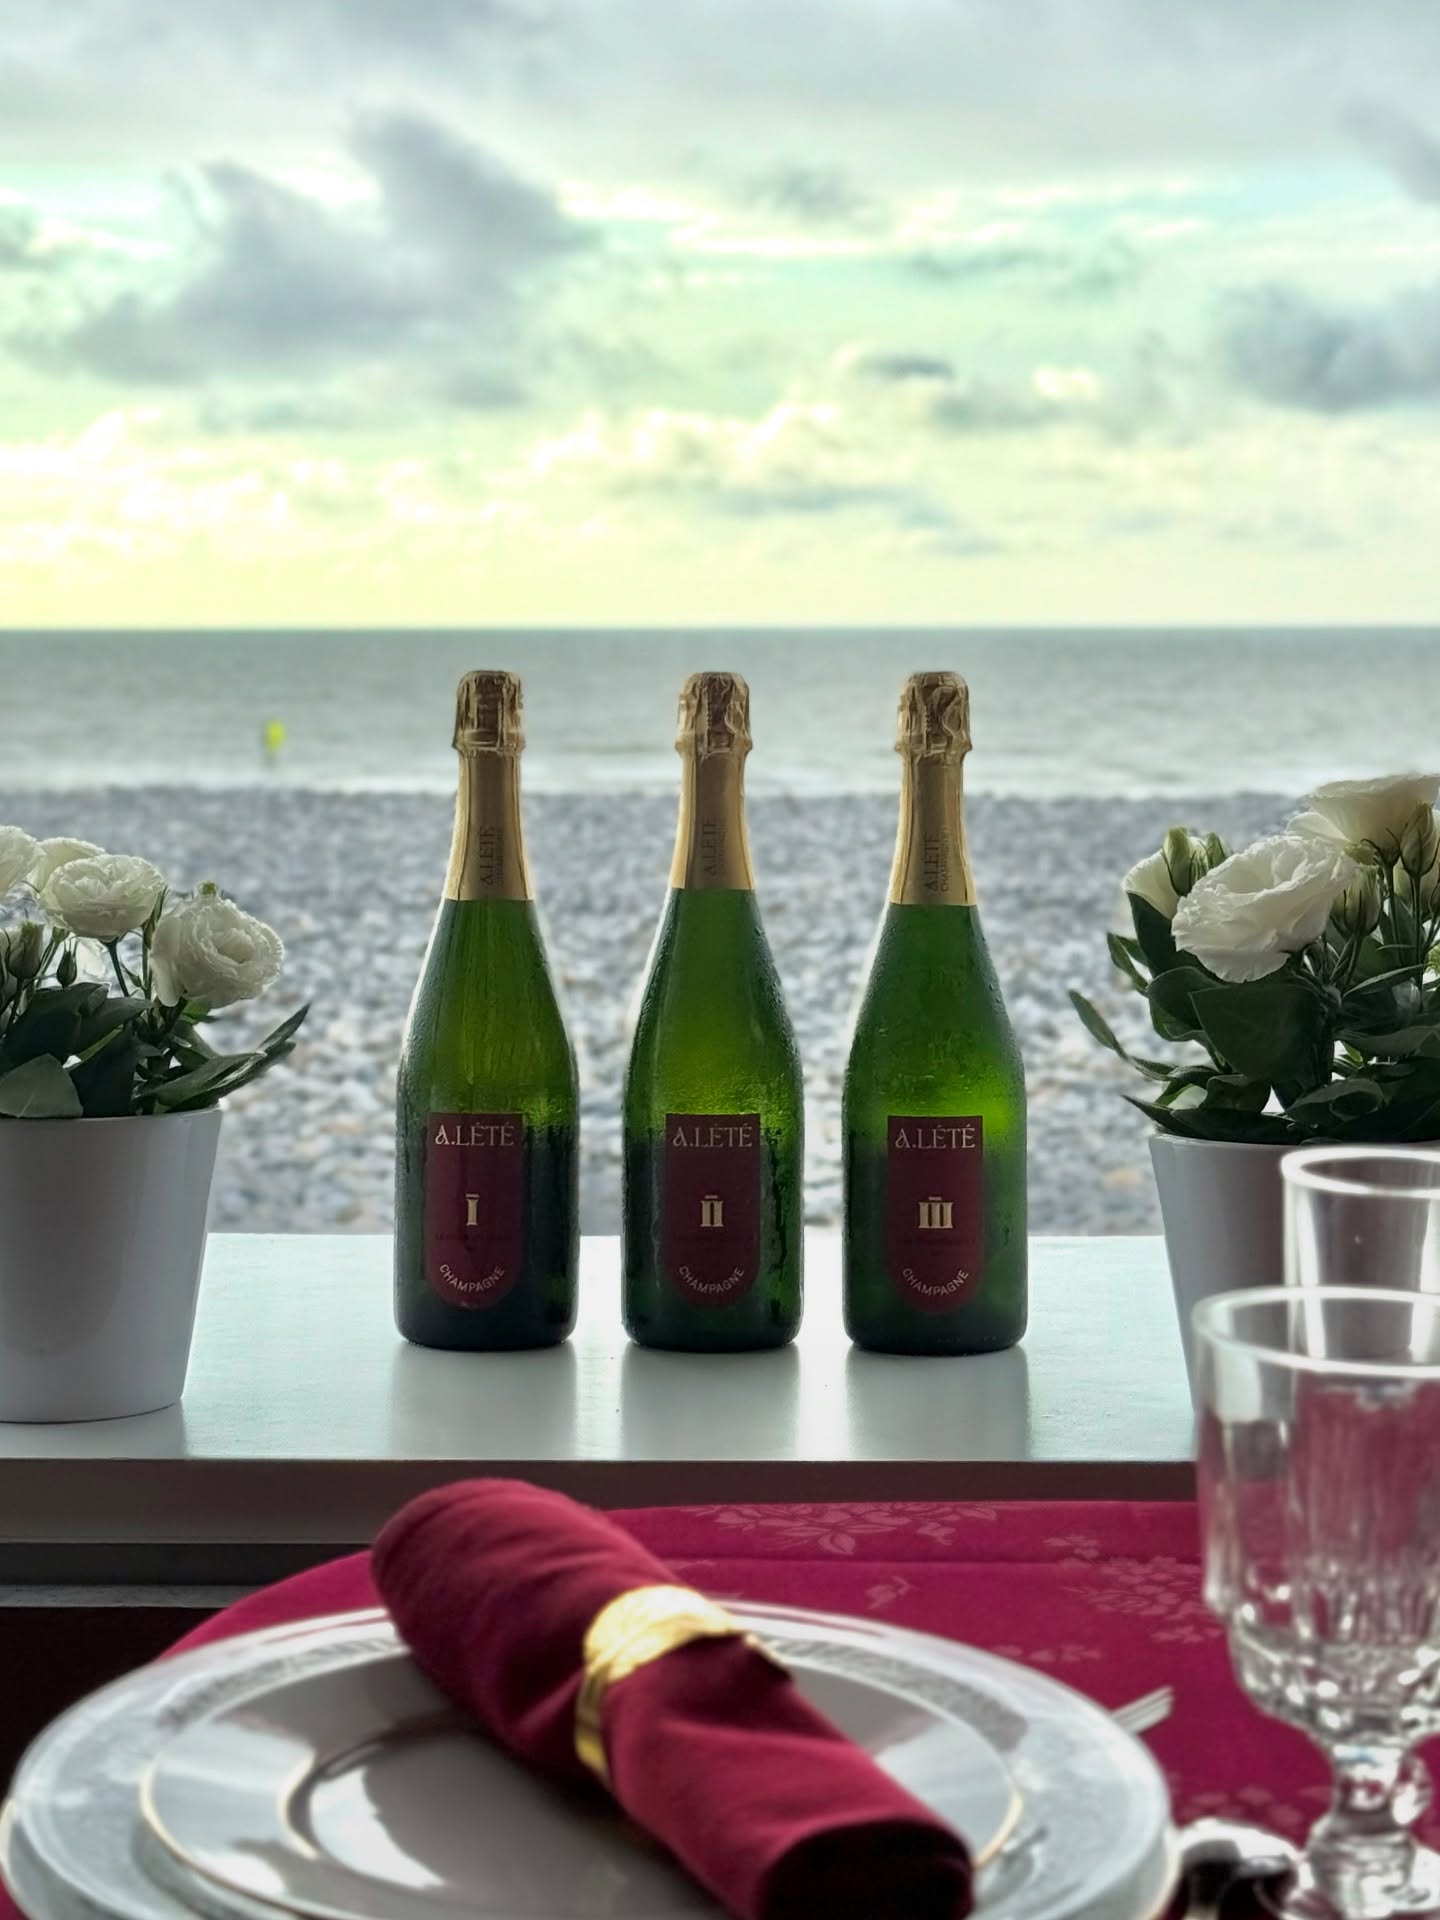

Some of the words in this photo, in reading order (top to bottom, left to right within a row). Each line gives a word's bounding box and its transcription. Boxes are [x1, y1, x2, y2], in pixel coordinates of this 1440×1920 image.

[435, 1122, 515, 1147] A.LÉTÉ
[672, 1123, 753, 1148] A.LÉTÉ
[895, 1124, 976, 1149] A.LÉTÉ
[439, 1263, 506, 1293] CHAMPAGNE
[678, 1265, 745, 1295] CHAMPAGNE
[902, 1267, 969, 1297] CHAMPAGNE
